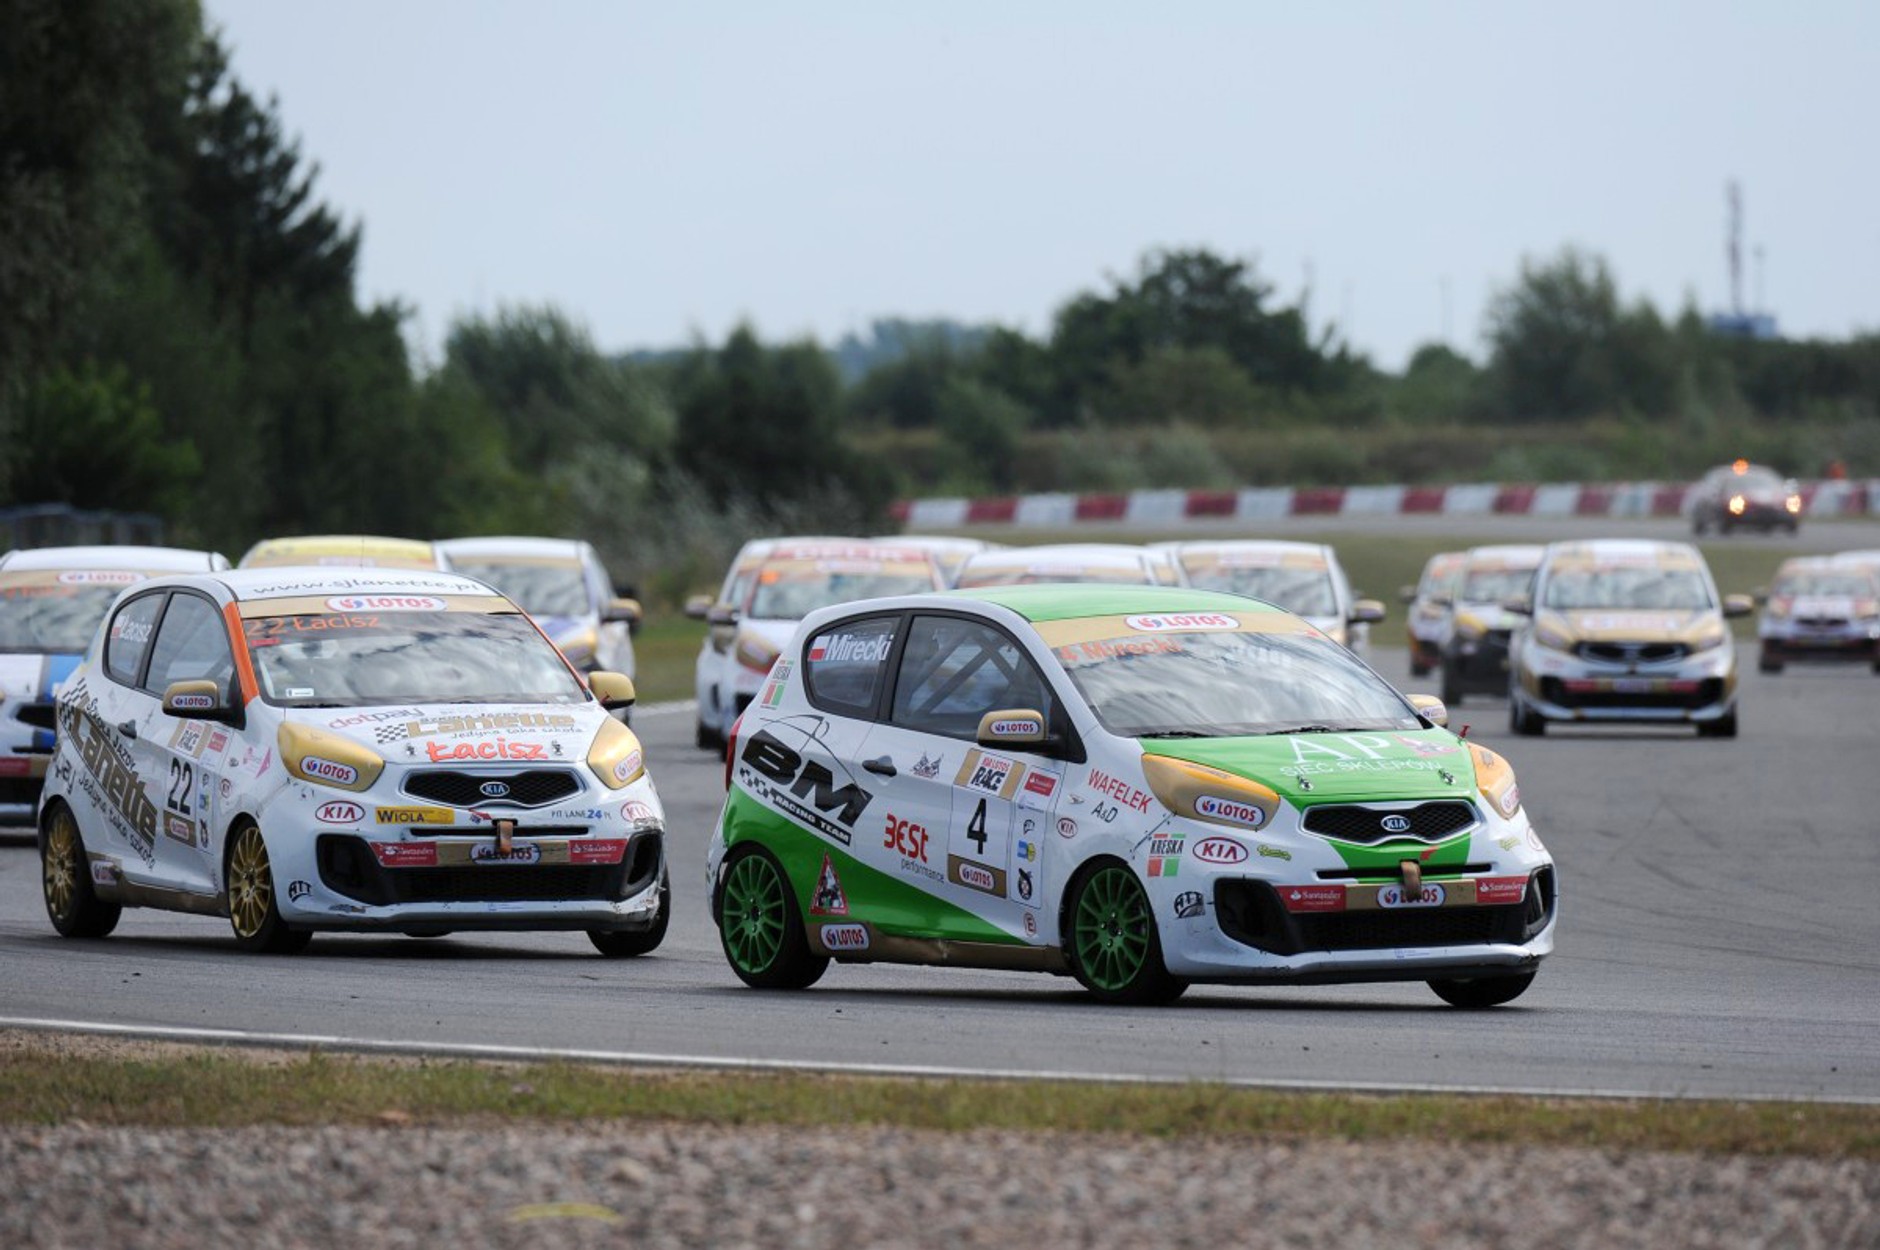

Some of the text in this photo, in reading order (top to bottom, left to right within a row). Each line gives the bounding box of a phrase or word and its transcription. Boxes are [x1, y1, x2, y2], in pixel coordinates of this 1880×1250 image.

[369, 597, 434, 609] LOTOS
[1163, 614, 1227, 627] LOTOS
[825, 634, 894, 661] Mirecki
[1082, 637, 1184, 660] Mirecki
[184, 697, 209, 706] LOTOS
[329, 707, 426, 730] dotpay
[405, 712, 576, 738] Lanette
[1006, 720, 1034, 732] LOTOS
[1288, 735, 1391, 765] AP
[317, 762, 352, 781] LOTOS
[741, 729, 873, 827] BM
[970, 766, 1006, 792] RACE
[167, 757, 193, 816] 22
[485, 784, 505, 794] KIA
[1088, 768, 1153, 814] WAFELEK
[323, 806, 356, 819] KIA
[626, 805, 650, 819] KIA
[775, 795, 849, 843] RACING TEAM
[1217, 802, 1256, 822] LOTOS
[966, 797, 988, 855] 4
[1060, 822, 1075, 834] KIA
[1386, 819, 1406, 829] KIA
[1150, 839, 1184, 855] KRESKA
[1201, 843, 1238, 860] KIA
[901, 858, 944, 884] performance
[969, 869, 992, 888] LOTOS
[1301, 889, 1341, 900] Santander
[1488, 881, 1525, 891] Santander
[1400, 888, 1438, 904] LOS
[836, 927, 865, 946] LOTOS
